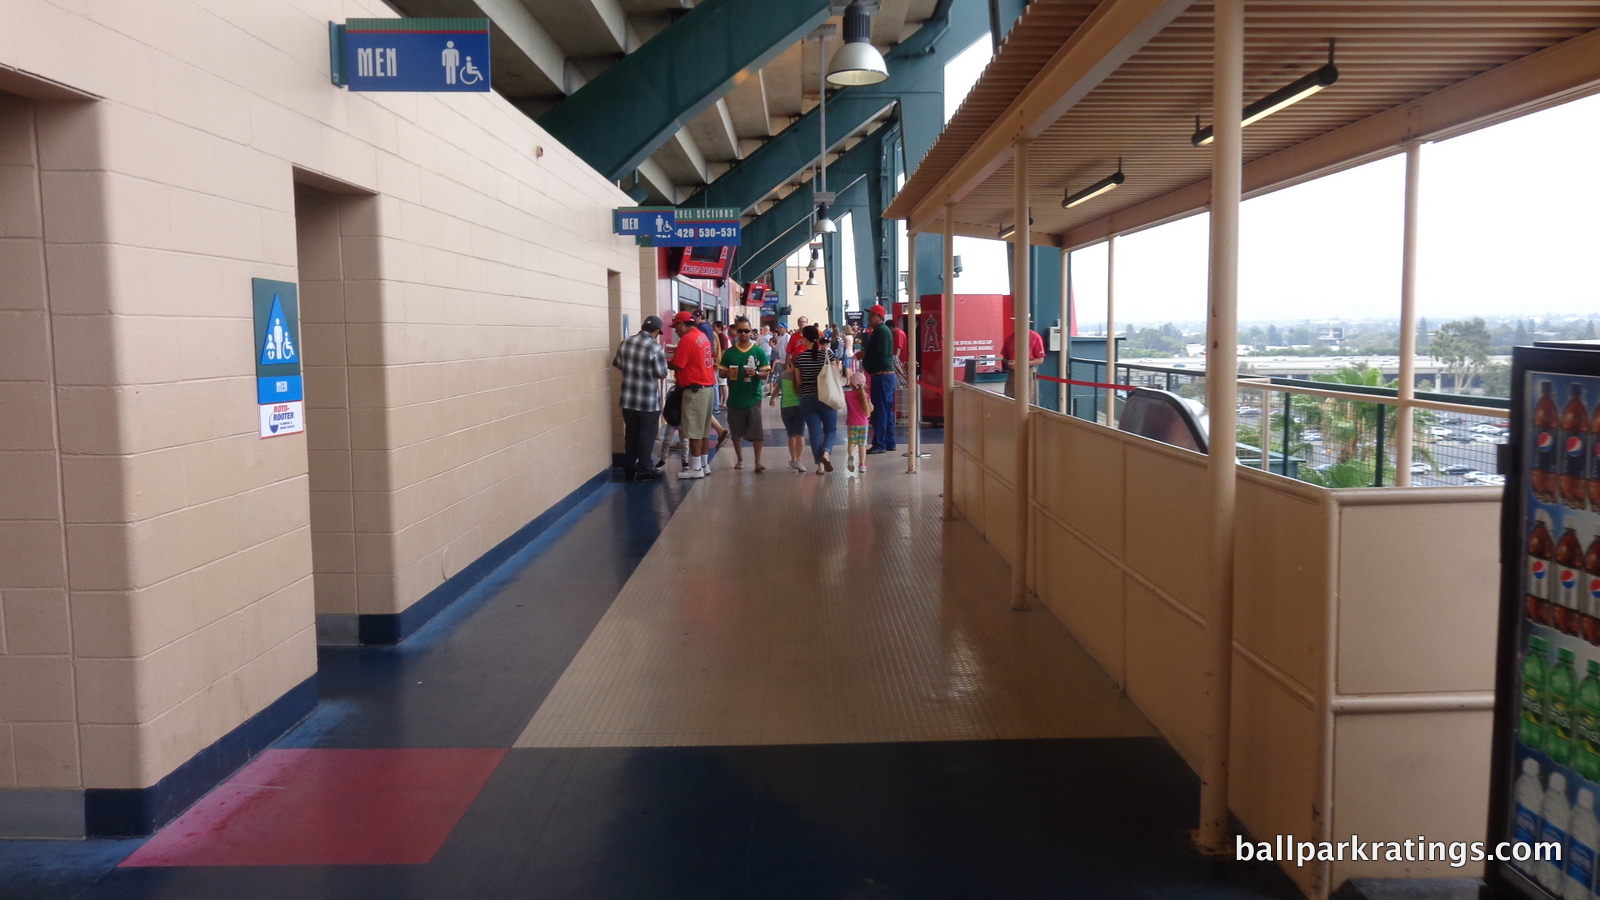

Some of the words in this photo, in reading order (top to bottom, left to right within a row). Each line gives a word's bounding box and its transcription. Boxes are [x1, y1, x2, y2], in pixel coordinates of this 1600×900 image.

[357, 47, 397, 77] MEN
[675, 209, 692, 219] EVEL
[696, 209, 734, 219] SECTIONS
[622, 217, 639, 230] MEN
[699, 227, 736, 237] 530-531
[275, 381, 288, 392] MEN
[273, 405, 290, 413] ROTO-
[273, 411, 294, 421] ROOTER
